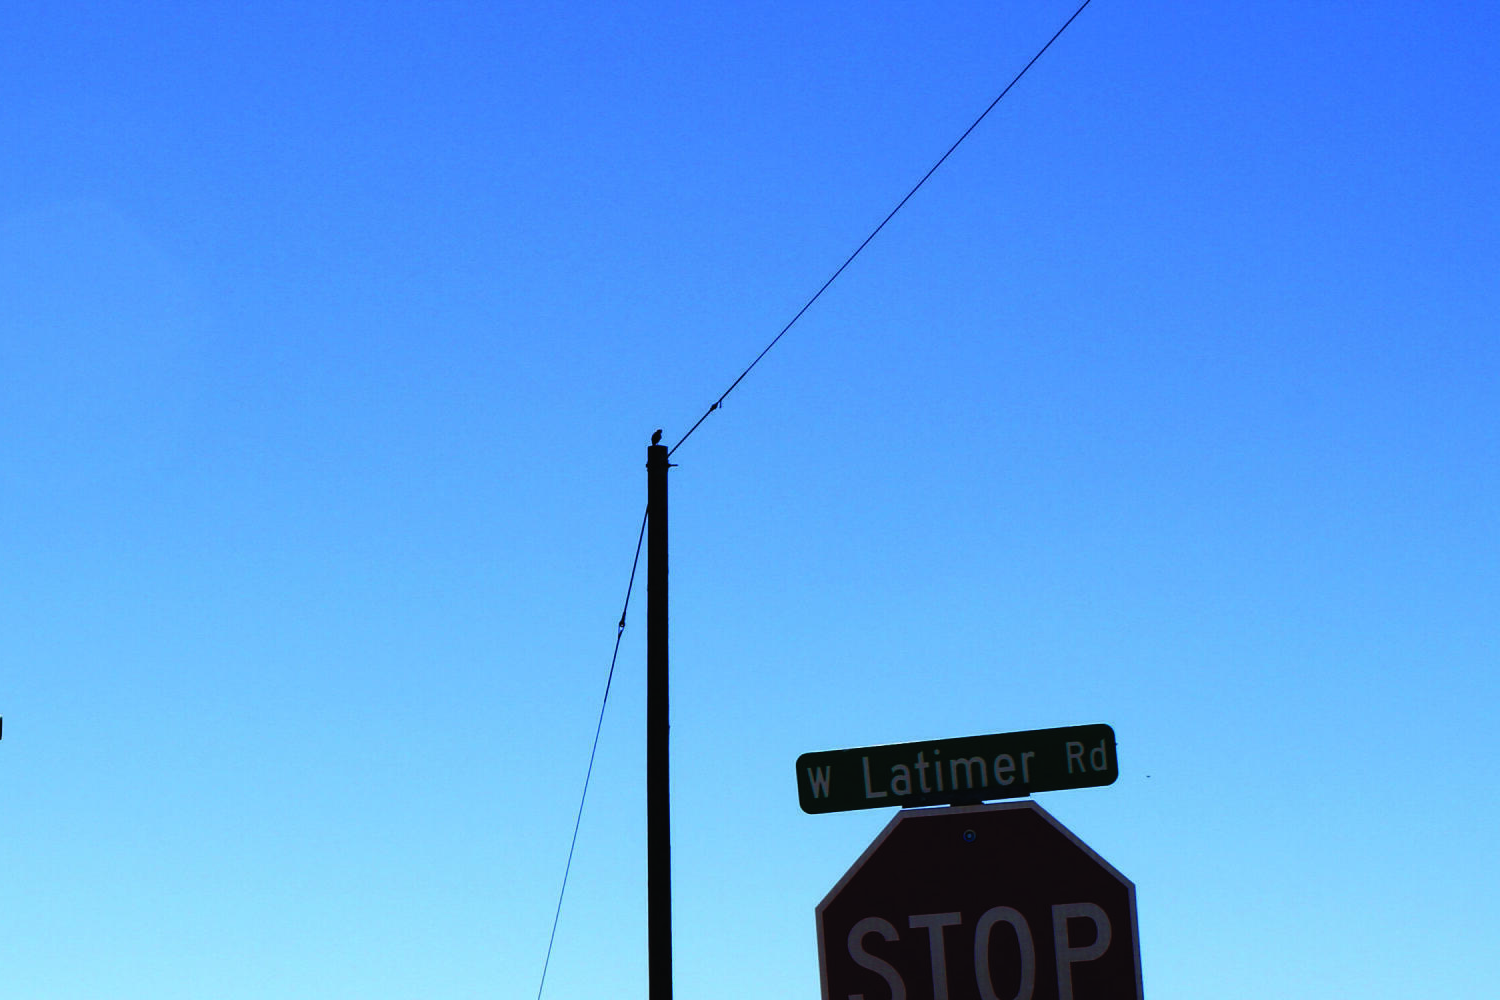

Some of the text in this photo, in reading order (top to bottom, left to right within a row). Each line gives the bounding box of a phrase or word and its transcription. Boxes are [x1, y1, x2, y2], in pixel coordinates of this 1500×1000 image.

[808, 739, 1107, 799] W Latimer Rd
